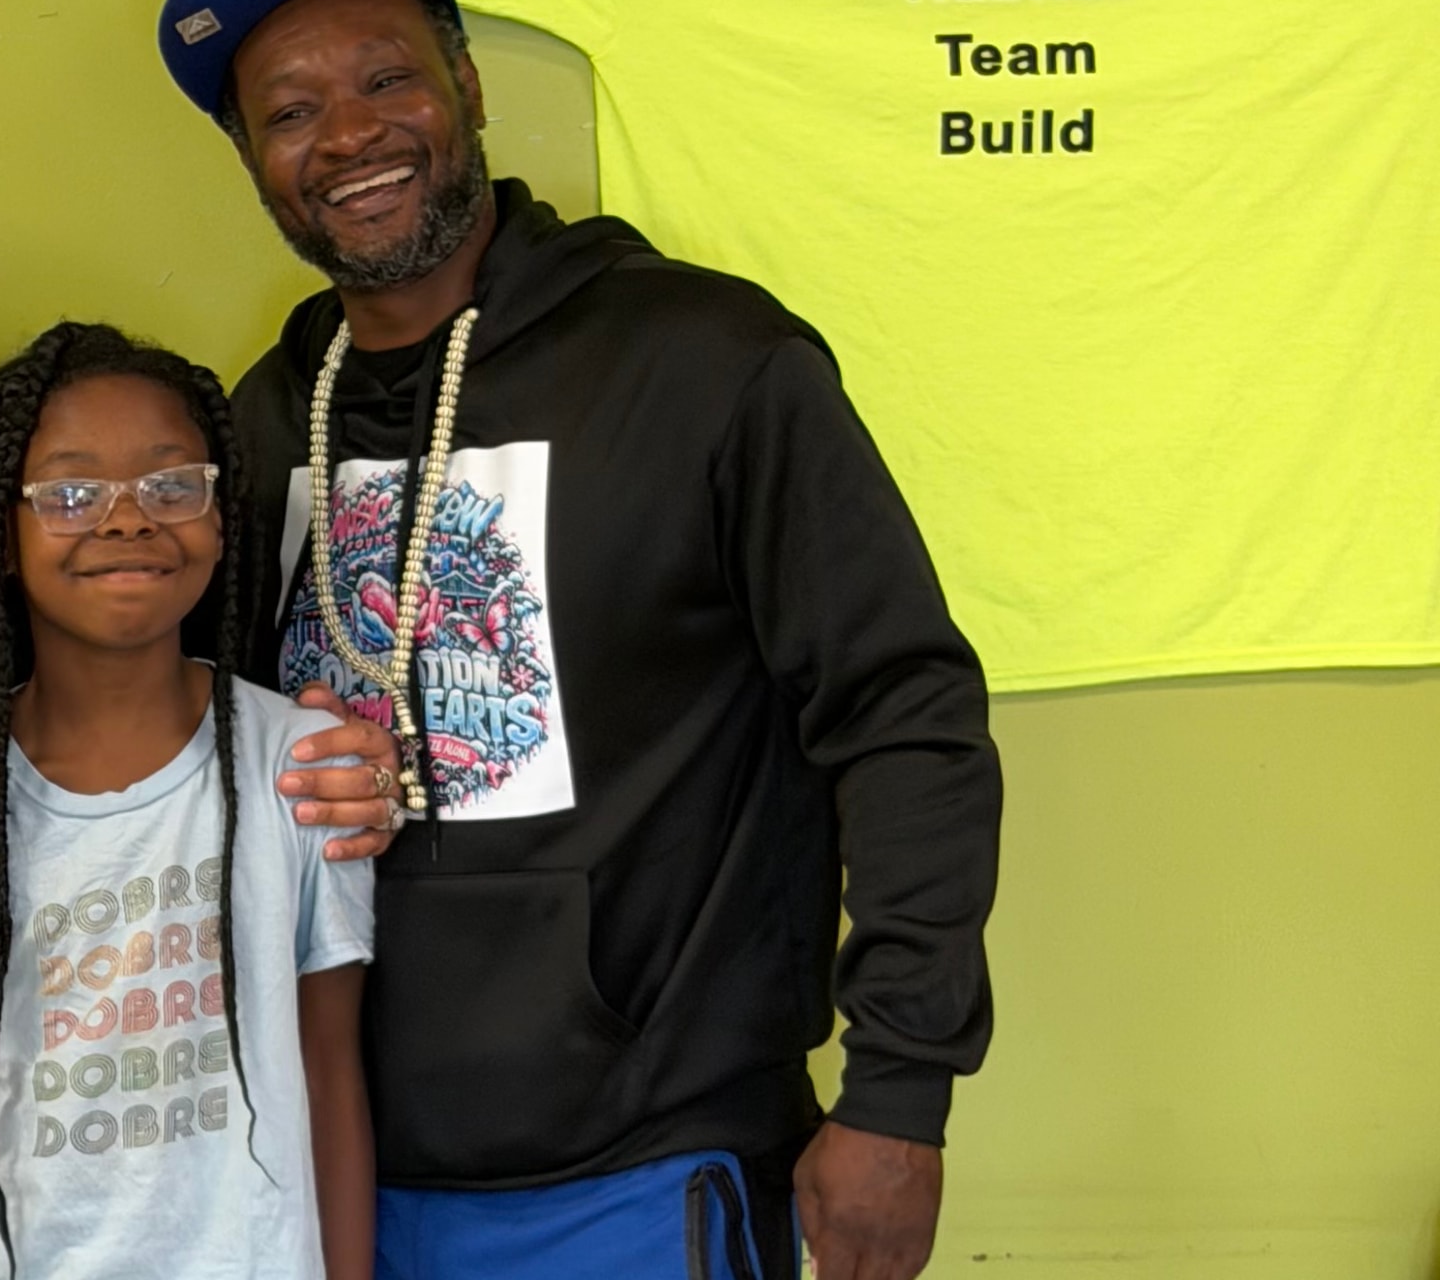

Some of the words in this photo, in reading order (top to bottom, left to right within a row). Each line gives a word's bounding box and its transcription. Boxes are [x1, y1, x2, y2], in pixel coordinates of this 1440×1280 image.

[935, 33, 1097, 76] Team
[940, 108, 1094, 155] Build
[421, 685, 542, 746] EARTS
[33, 857, 222, 950] DOBRE
[39, 915, 222, 997] DOBRE
[42, 973, 226, 1052] DOBRE
[32, 1028, 228, 1102] DOBRE
[32, 1086, 228, 1158] DOBRE
